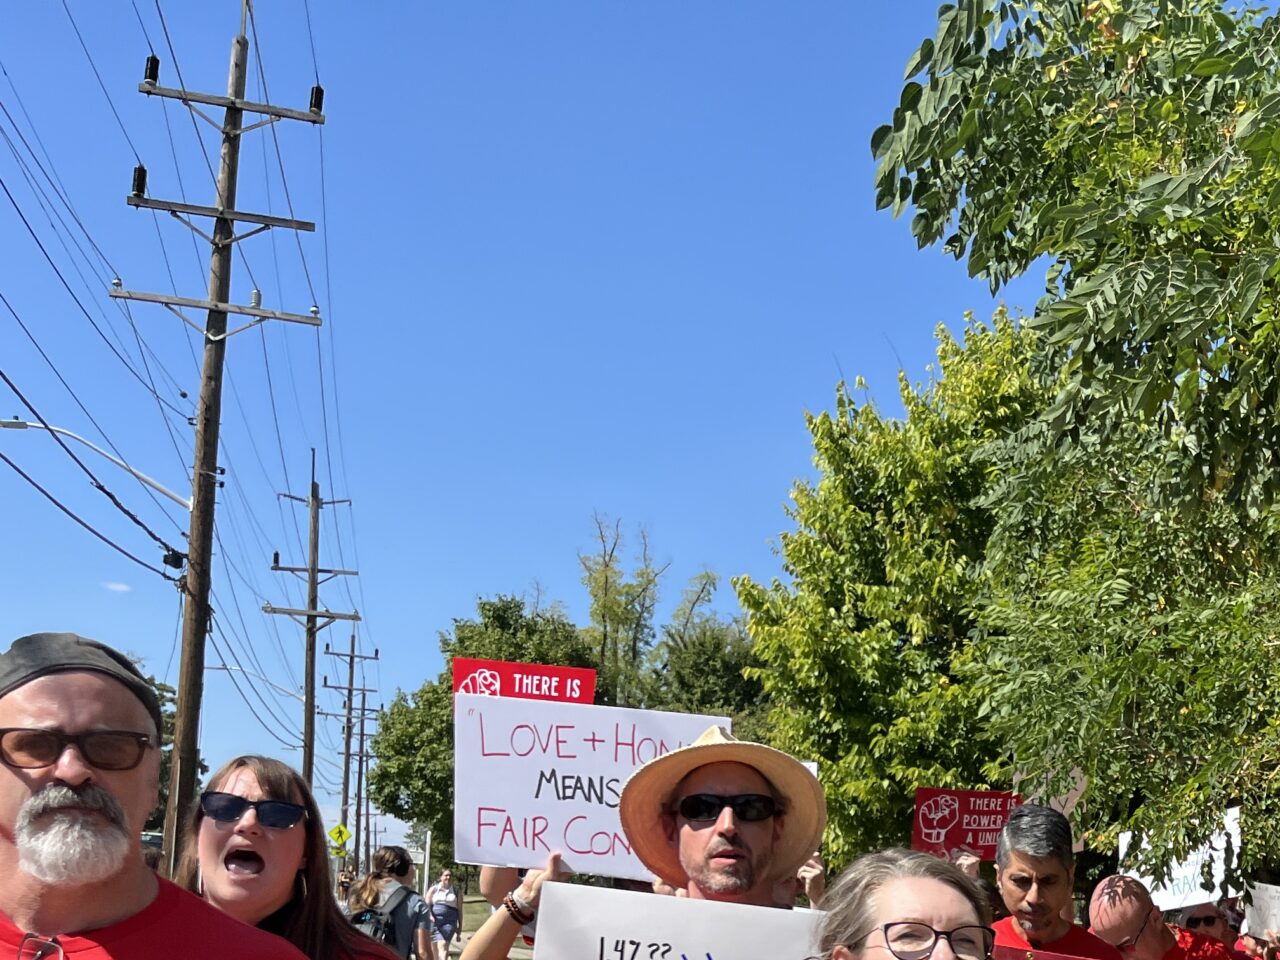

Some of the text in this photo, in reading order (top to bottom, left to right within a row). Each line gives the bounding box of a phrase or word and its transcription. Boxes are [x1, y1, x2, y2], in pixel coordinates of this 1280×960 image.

[513, 673, 580, 698] THERE IS
[584, 731, 605, 751] +
[535, 768, 620, 808] MEANS
[970, 797, 1016, 811] THERE IS
[477, 807, 551, 851] FAIR
[963, 815, 1003, 829] POWER
[966, 832, 973, 844] A
